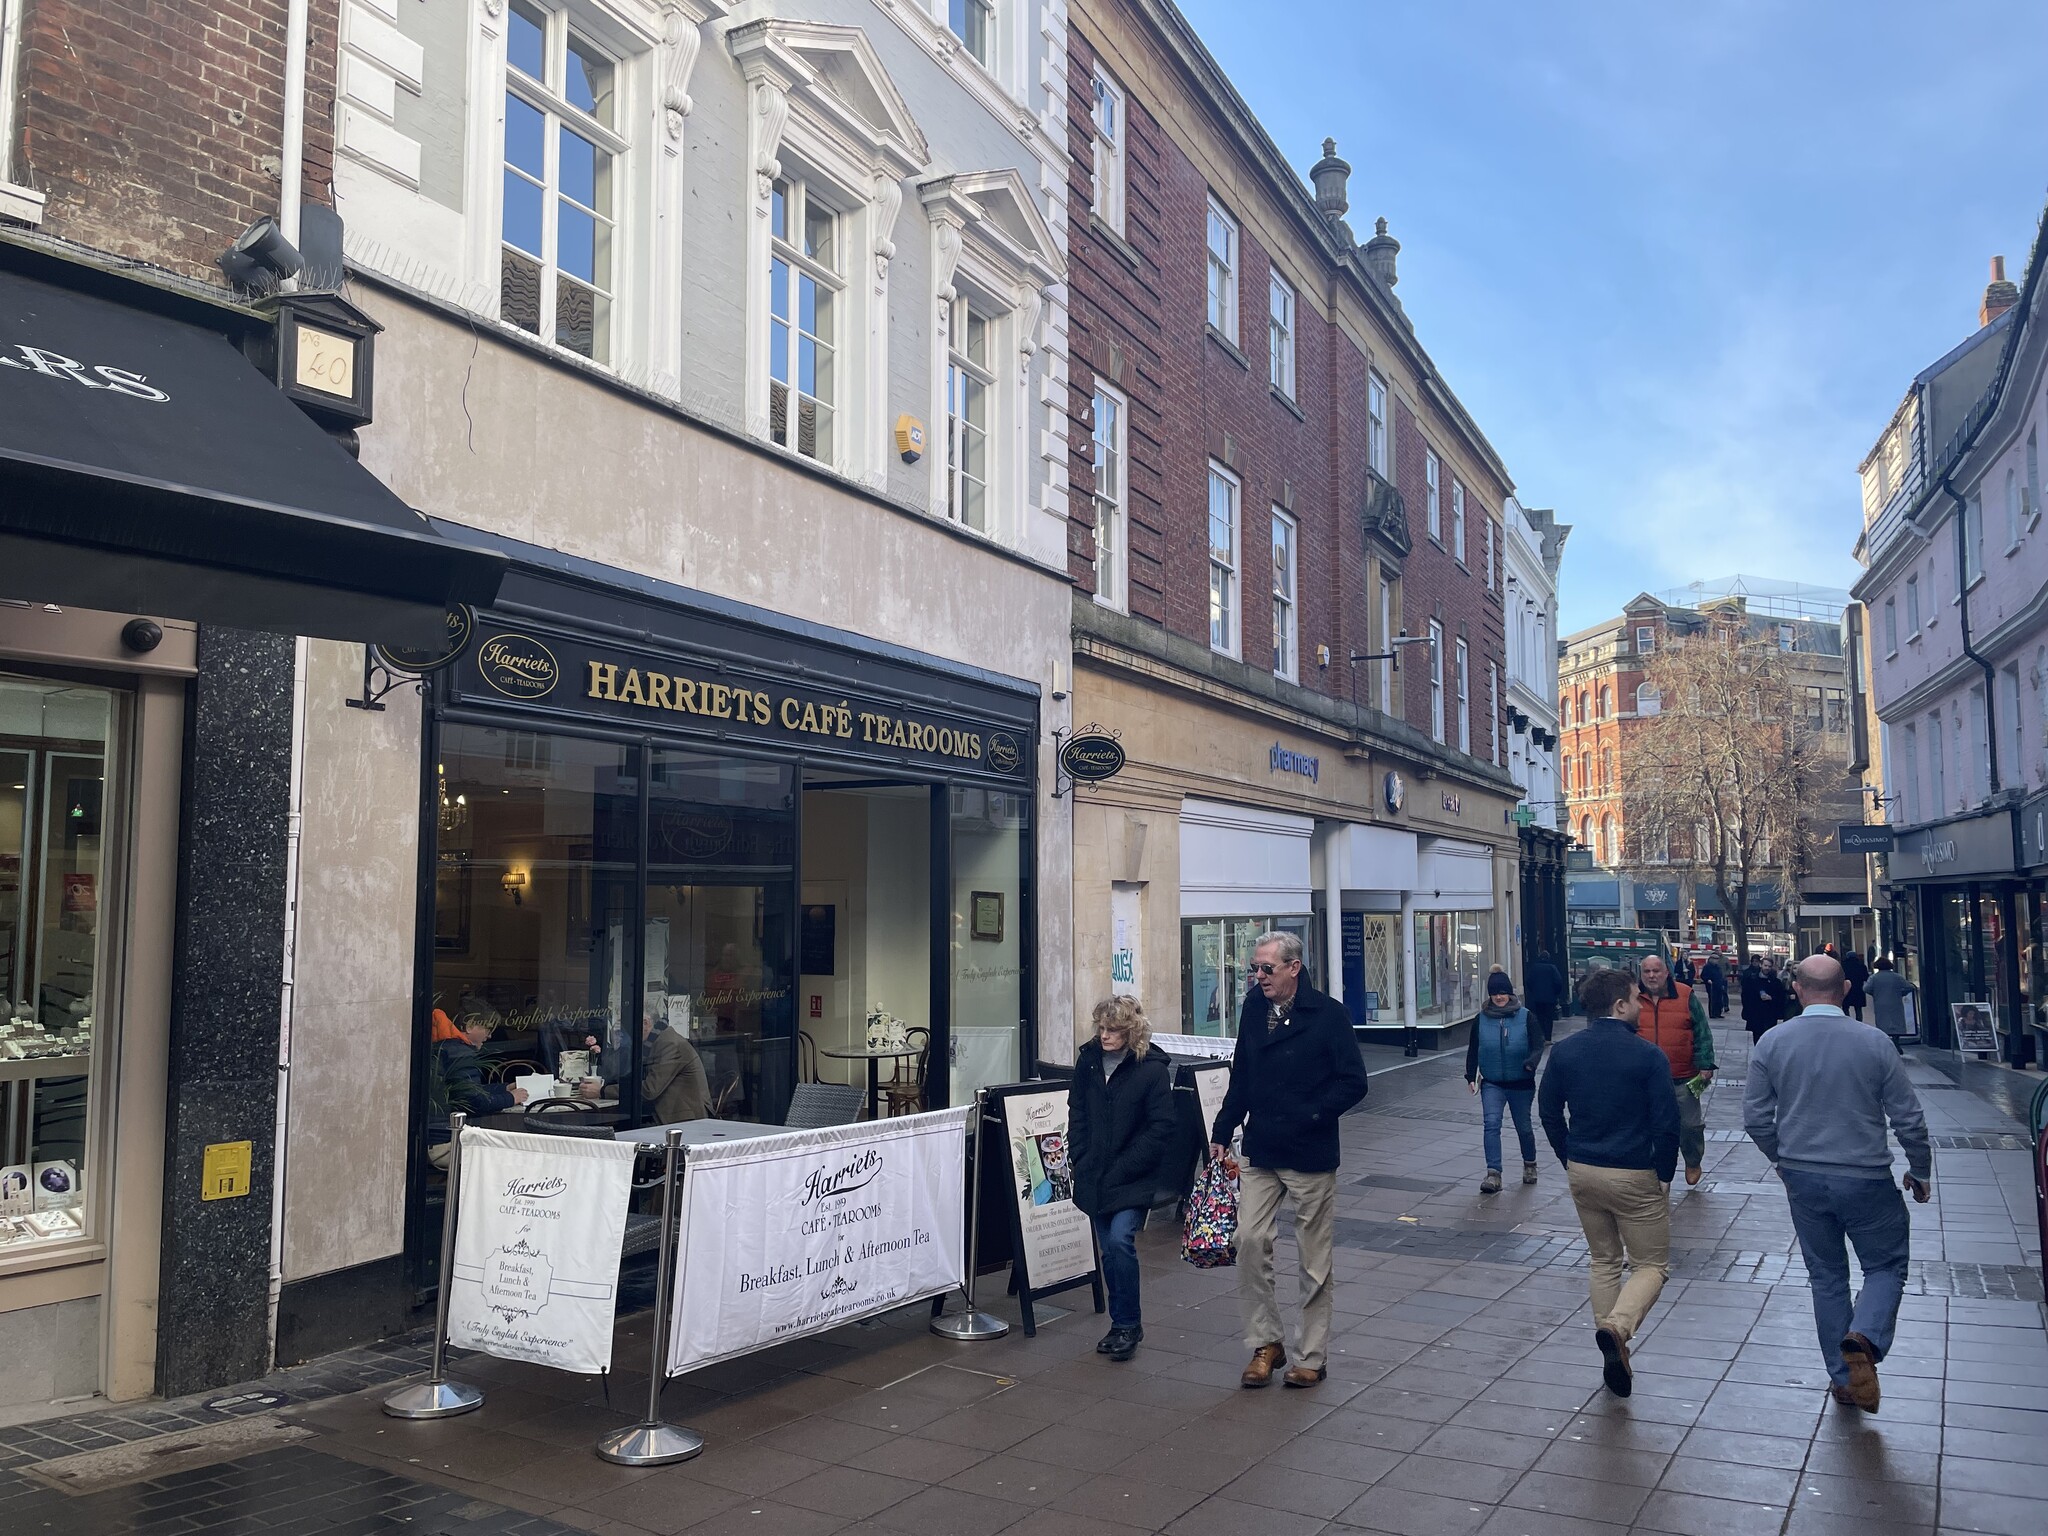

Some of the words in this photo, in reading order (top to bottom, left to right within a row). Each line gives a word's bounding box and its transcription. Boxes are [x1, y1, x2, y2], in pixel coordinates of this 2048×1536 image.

[0, 344, 172, 403] RS
[308, 352, 347, 385] 40
[484, 643, 553, 677] Harriets
[516, 679, 546, 690] TEAROOMS
[587, 660, 772, 726] HARRIETS
[780, 698, 853, 739] CAFÉ
[860, 712, 982, 760] TEAROOMS
[1068, 746, 1117, 763] Harriets
[1270, 741, 1319, 784] pharmacy
[1844, 835, 1889, 846] BRAVISSIMO
[696, 989, 733, 1011] English
[505, 1006, 553, 1031] English
[1025, 1101, 1054, 1121] Harriets
[503, 1176, 567, 1200] Harriets
[801, 1150, 882, 1206] Harriets
[499, 1204, 516, 1215] CAFÉ
[521, 1207, 561, 1220] TEAROOMS
[820, 1202, 833, 1213] Est.
[515, 1224, 531, 1235] for
[801, 1214, 827, 1236] CAFÉ
[833, 1203, 882, 1228] TEAROOMS
[837, 1232, 845, 1242] for
[499, 1261, 534, 1275] Breakfast,
[739, 1262, 802, 1293] Breakfast,
[805, 1250, 841, 1276] Lunch
[844, 1246, 855, 1264] &
[858, 1236, 911, 1261] Afternoon
[913, 1227, 931, 1246] Tea
[499, 1273, 522, 1286] Lunch
[523, 1276, 530, 1286] &
[488, 1285, 523, 1299] Afternoon
[523, 1288, 537, 1300] Tea
[774, 1287, 897, 1334] www.harrietscafetearooms.co.uk
[471, 1321, 489, 1338] Truly
[491, 1326, 519, 1341] English
